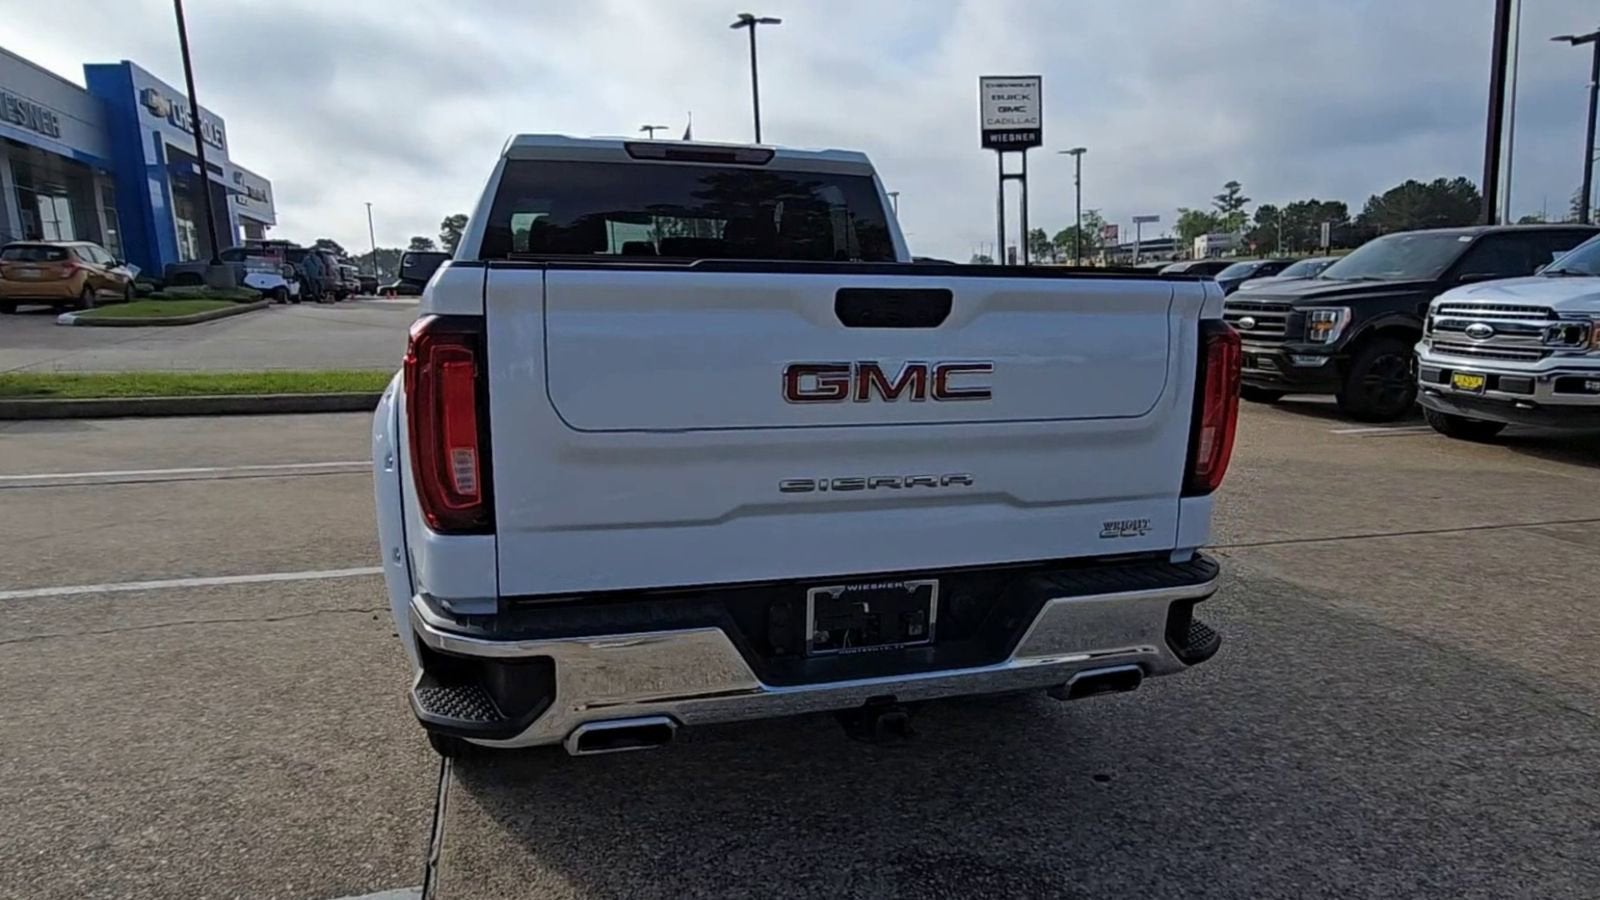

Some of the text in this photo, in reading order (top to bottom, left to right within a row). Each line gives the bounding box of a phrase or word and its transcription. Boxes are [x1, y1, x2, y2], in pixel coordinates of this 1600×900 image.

[0, 92, 61, 138] IESNER
[170, 100, 223, 149] CHEOLET
[987, 117, 1036, 125] CADILLAC
[990, 133, 1035, 142] WIESNER
[782, 360, 993, 404] GMC
[779, 473, 974, 493] SIERRA
[847, 583, 902, 591] WIESNER
